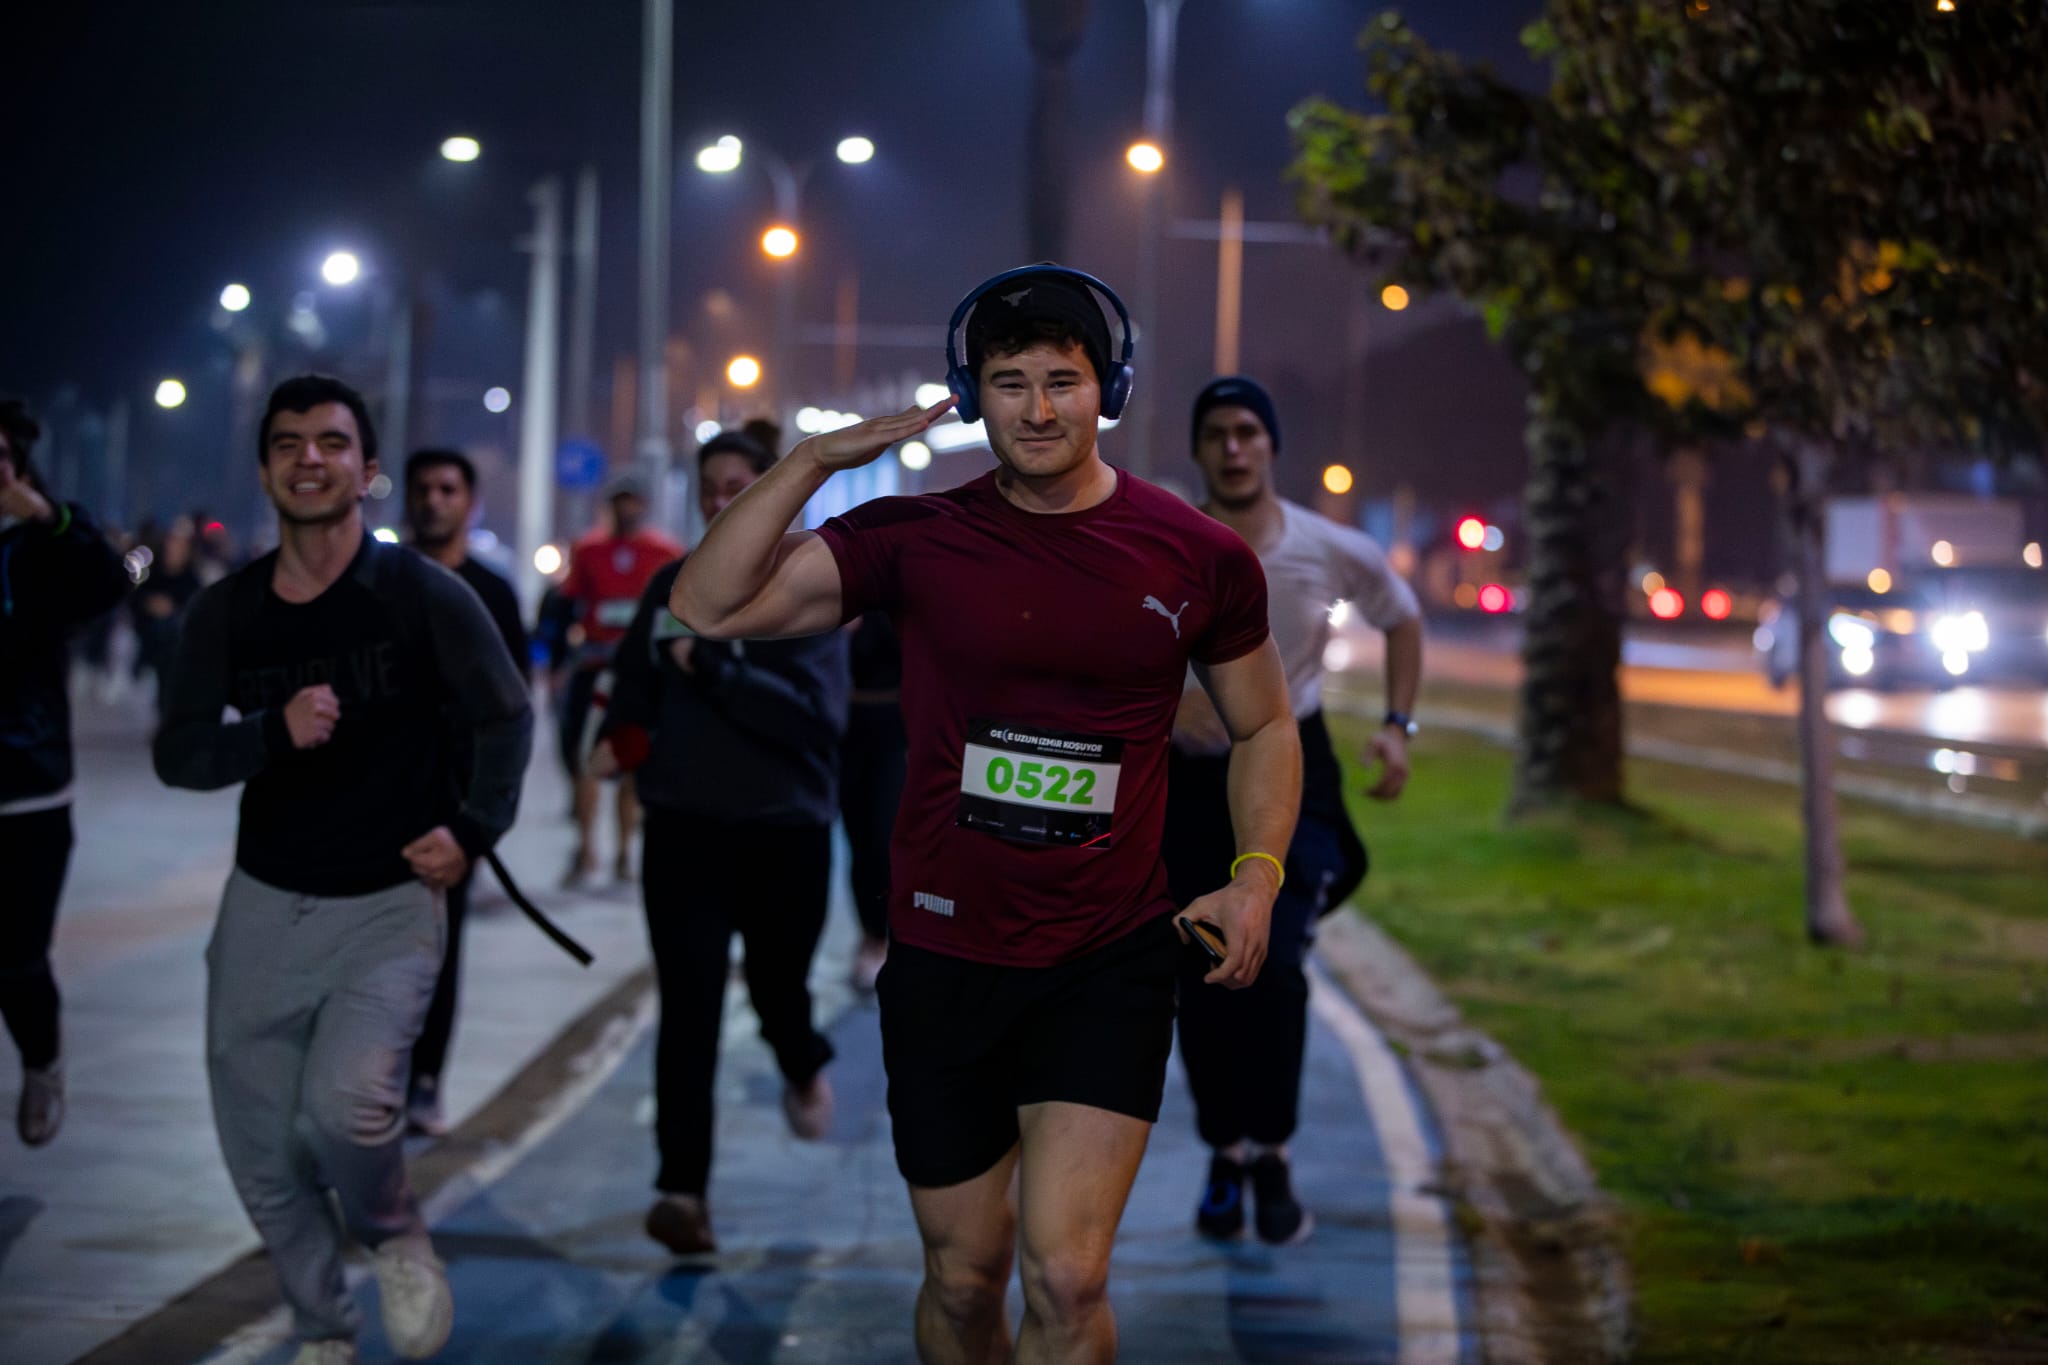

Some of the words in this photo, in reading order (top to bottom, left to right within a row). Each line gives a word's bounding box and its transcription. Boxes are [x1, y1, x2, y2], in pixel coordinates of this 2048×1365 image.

[1014, 733, 1039, 745] UZUN
[985, 756, 1097, 806] 0522
[913, 891, 956, 918] PUMA
